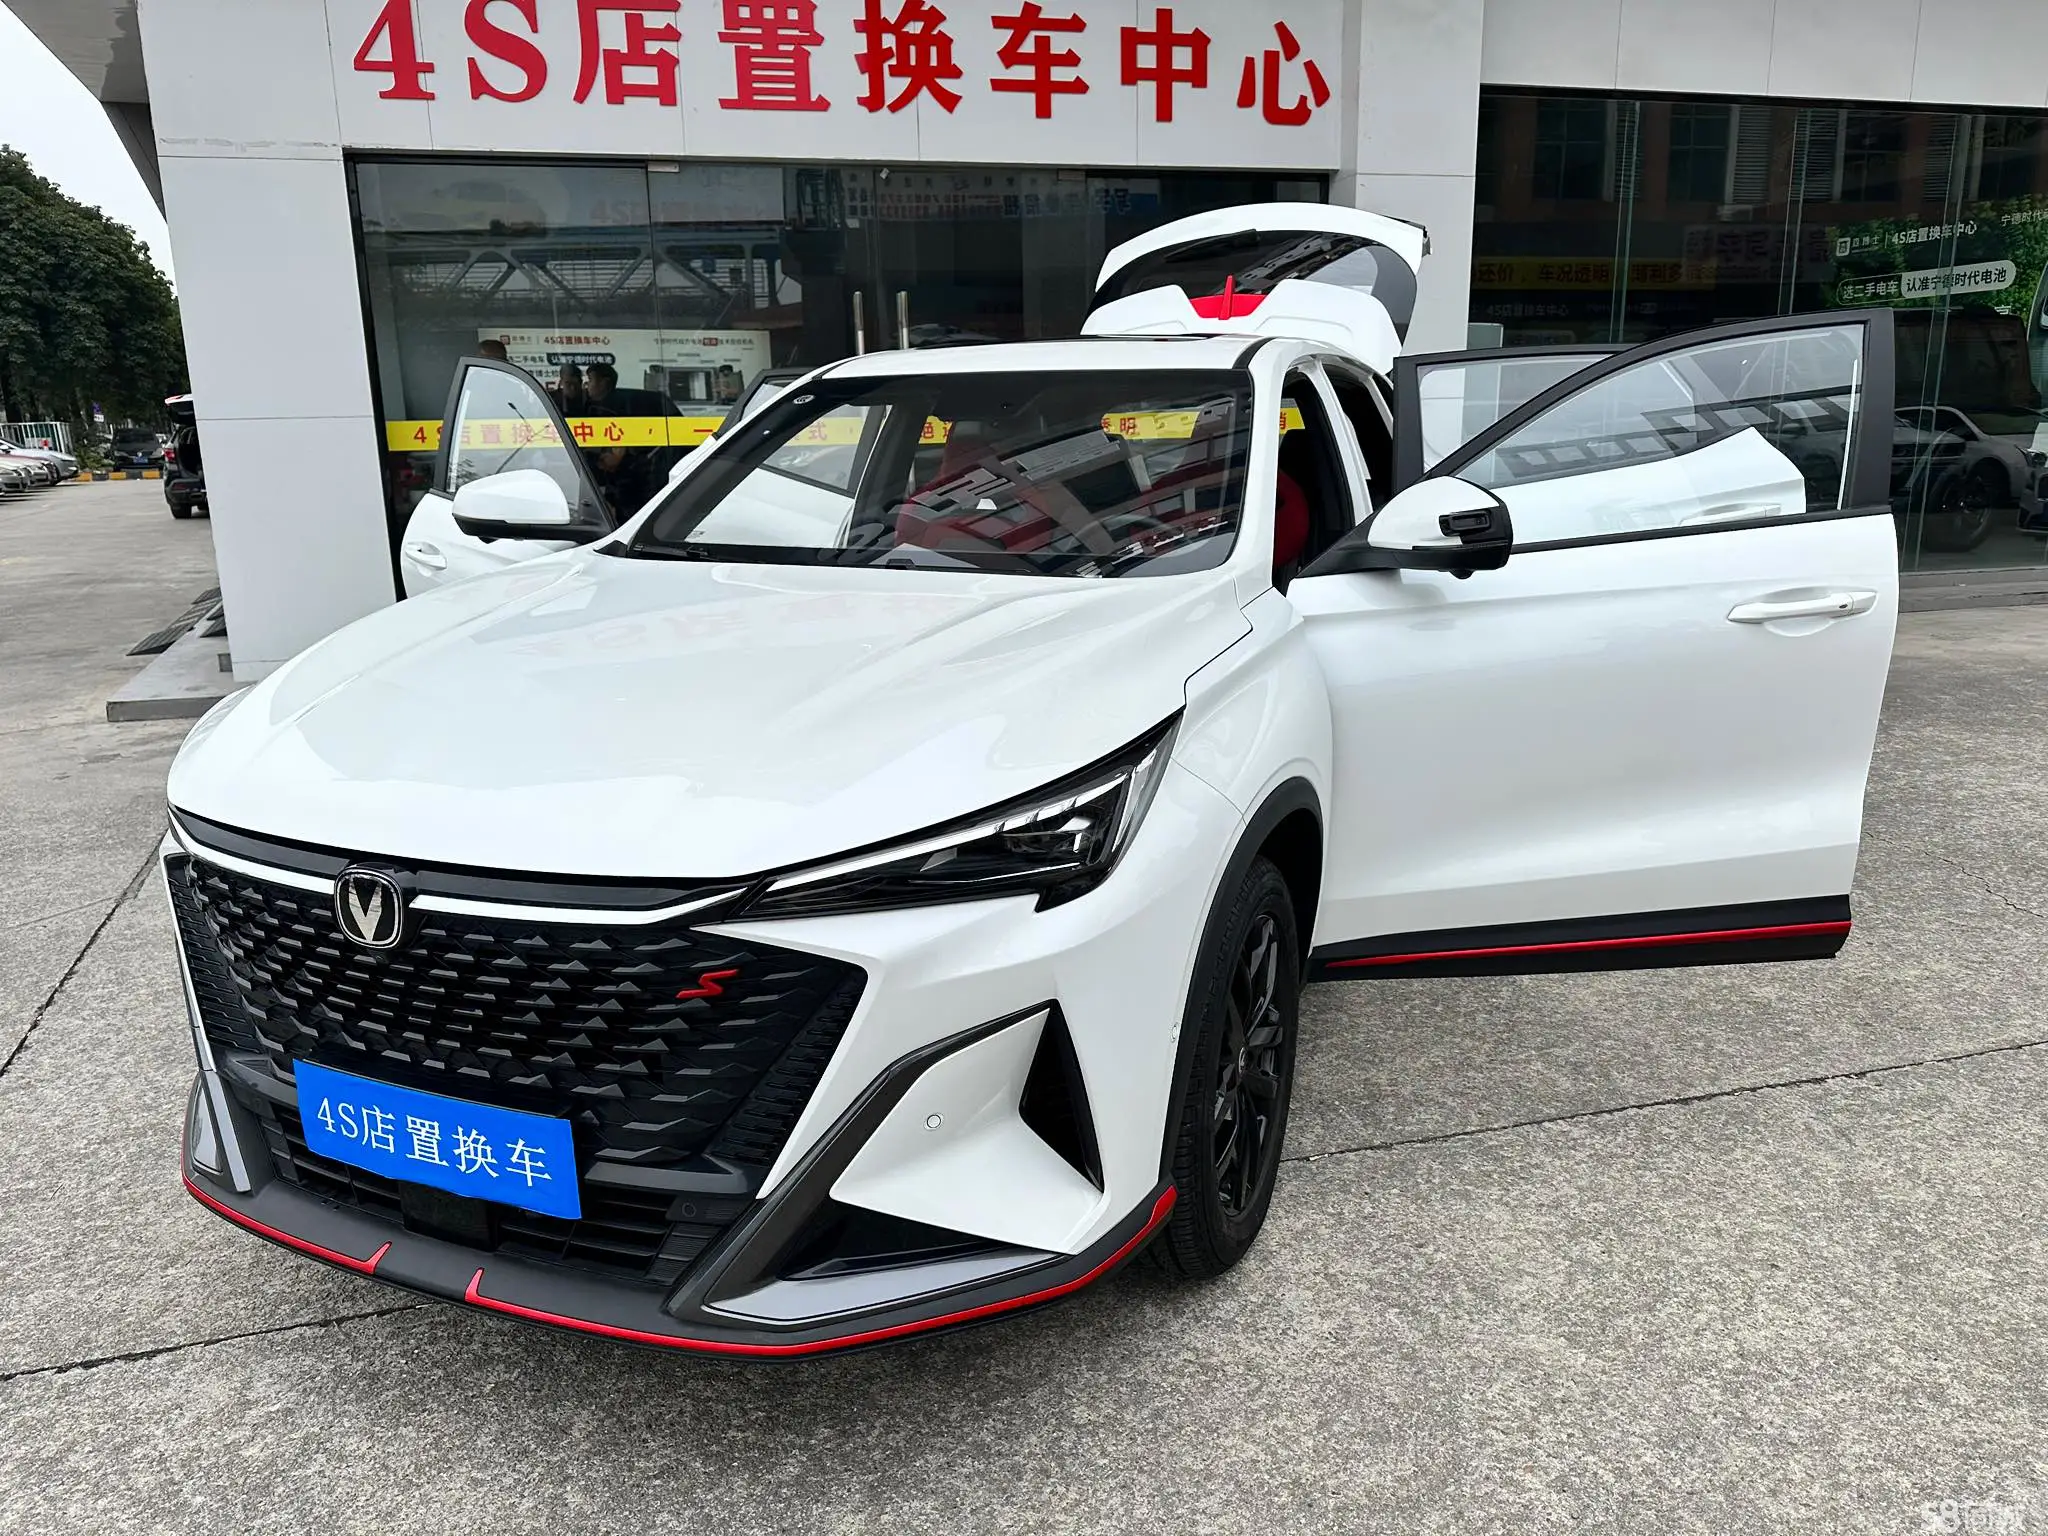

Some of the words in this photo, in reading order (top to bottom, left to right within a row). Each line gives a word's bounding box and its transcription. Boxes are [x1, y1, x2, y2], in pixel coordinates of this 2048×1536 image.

[354, 0, 1331, 126] 4S店置换车中心
[1891, 220, 1978, 245] 4S店置换车中心
[1843, 281, 1899, 300] 选二手电车
[1906, 267, 2007, 293] 认准宁德时代电池
[317, 1097, 552, 1187] 4S店置换车
